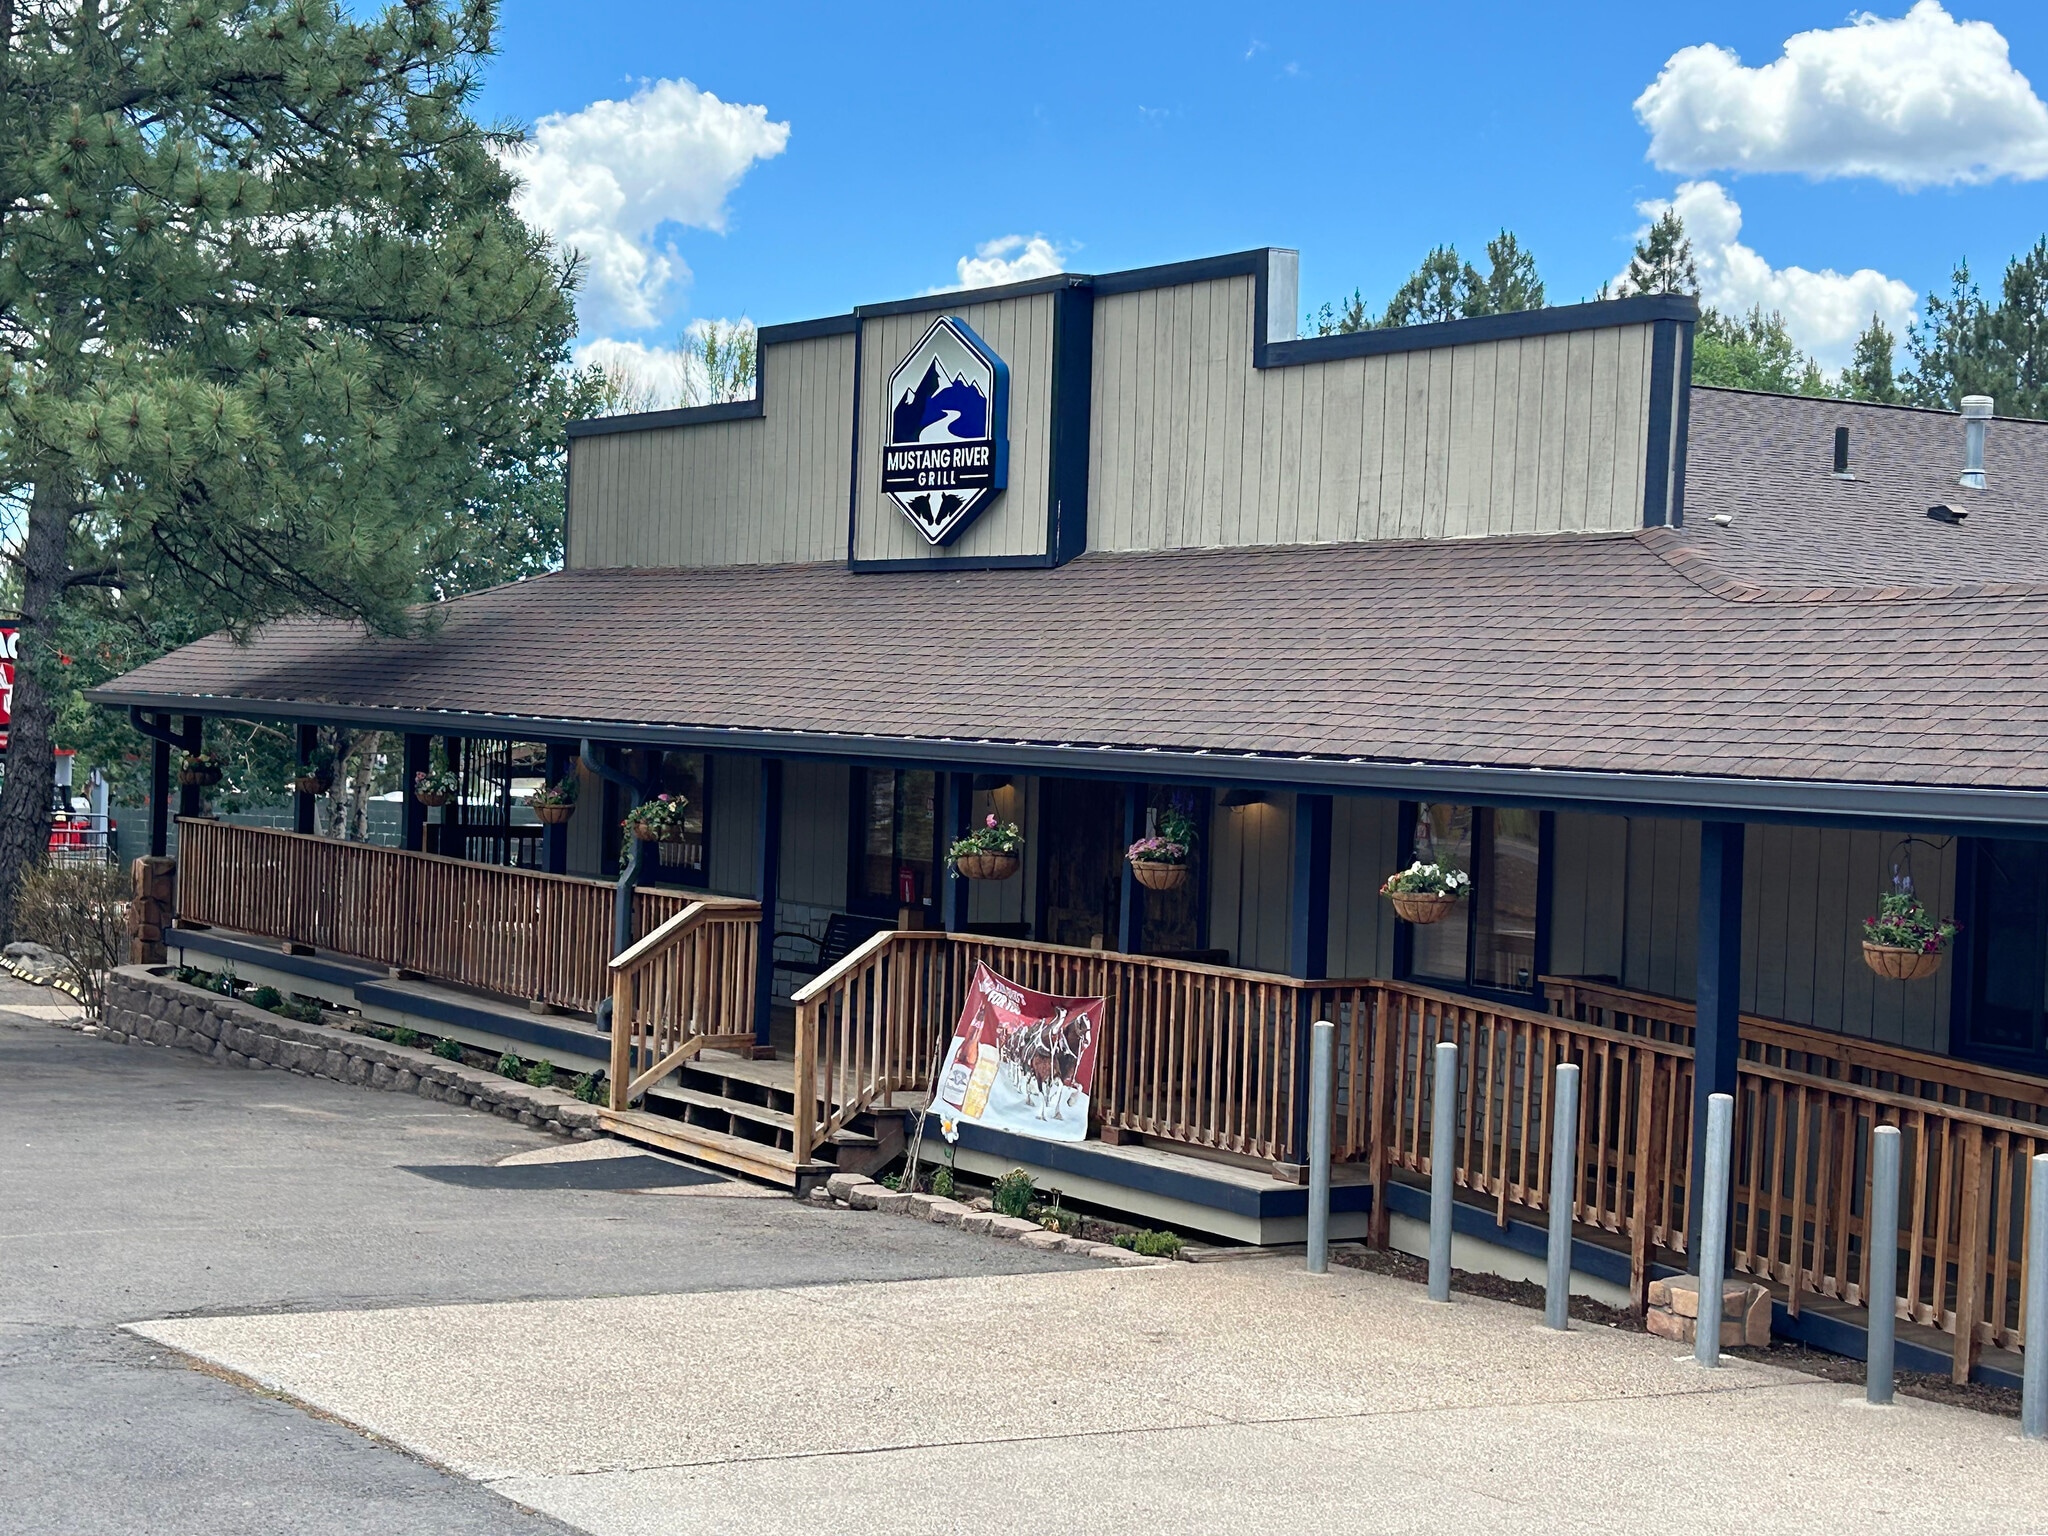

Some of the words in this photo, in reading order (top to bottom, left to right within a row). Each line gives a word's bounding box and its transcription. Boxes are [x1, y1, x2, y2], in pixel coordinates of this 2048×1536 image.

[887, 449, 950, 470] MUSTANG
[953, 446, 989, 467] RIVER
[918, 470, 956, 486] GRILL
